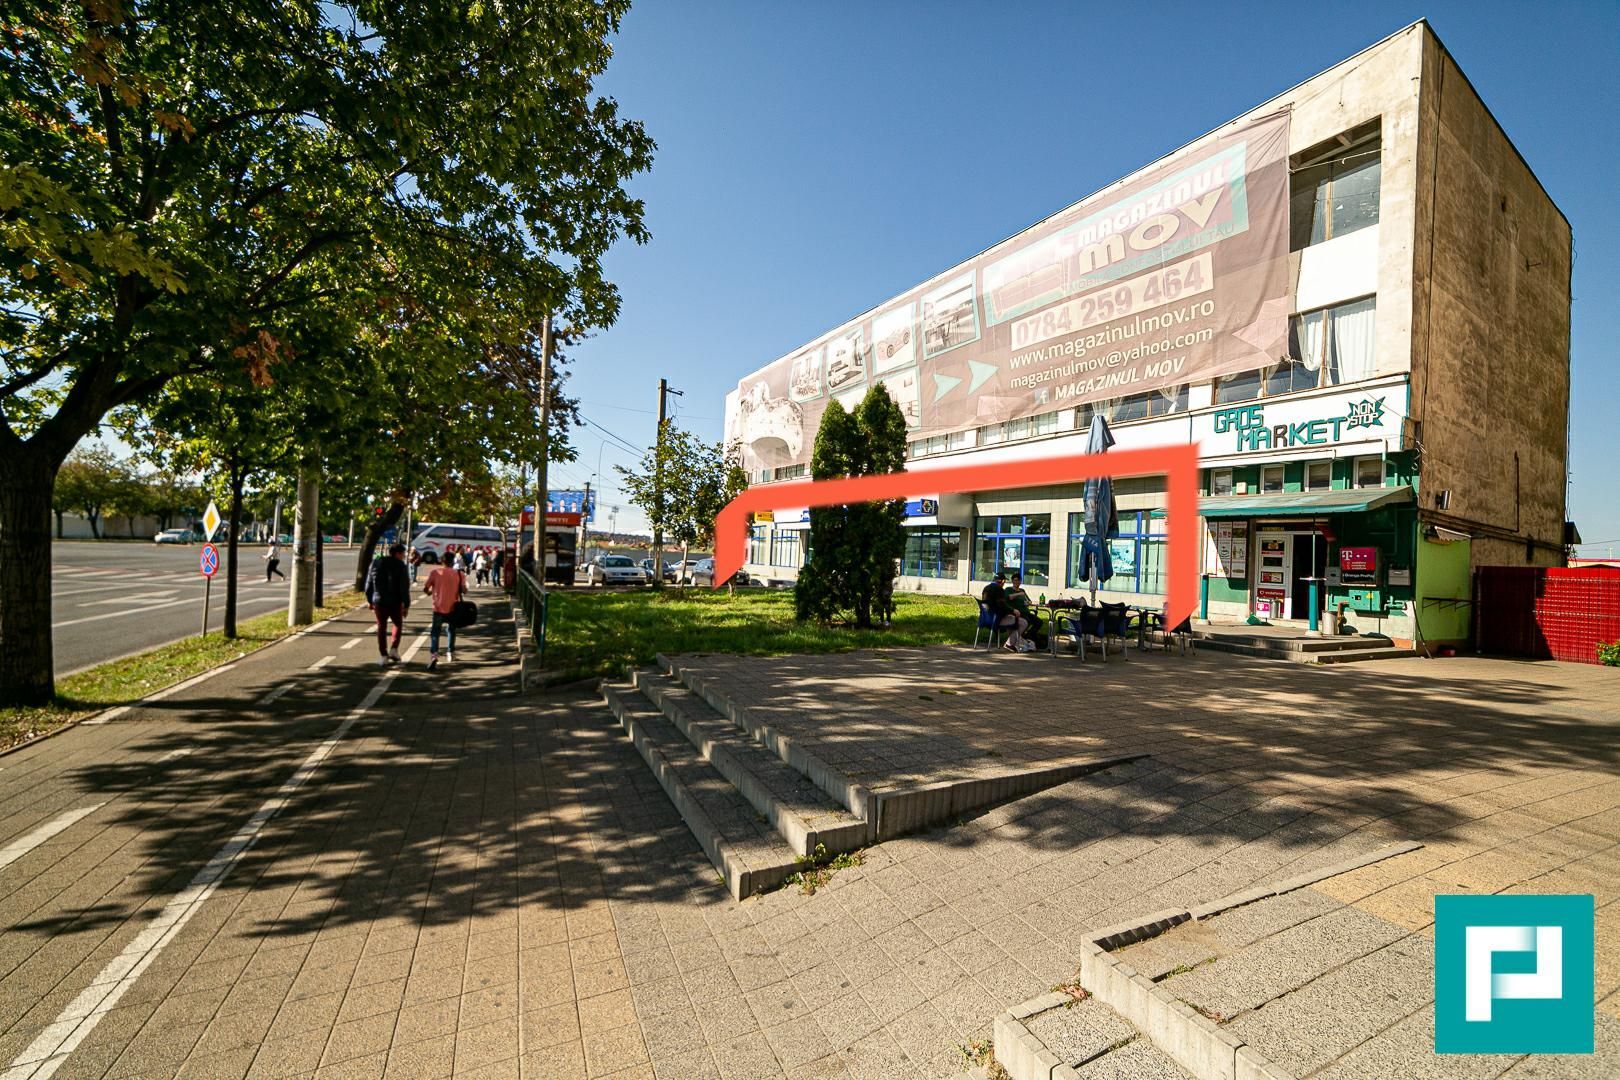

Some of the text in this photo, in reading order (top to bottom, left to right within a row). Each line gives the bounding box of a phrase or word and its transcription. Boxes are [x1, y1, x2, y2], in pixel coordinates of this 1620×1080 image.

[1016, 260, 1205, 346] 0784 259 464
[1009, 300, 1215, 370] www.magazinulmov.ro
[1010, 327, 1214, 389] magazinulmov@yahoo.com
[1055, 367, 1140, 400] MAGAZINUL
[1144, 356, 1186, 380] MOV
[1349, 412, 1379, 426] STOP
[1352, 402, 1376, 416] NON
[1237, 416, 1348, 452] MARKET
